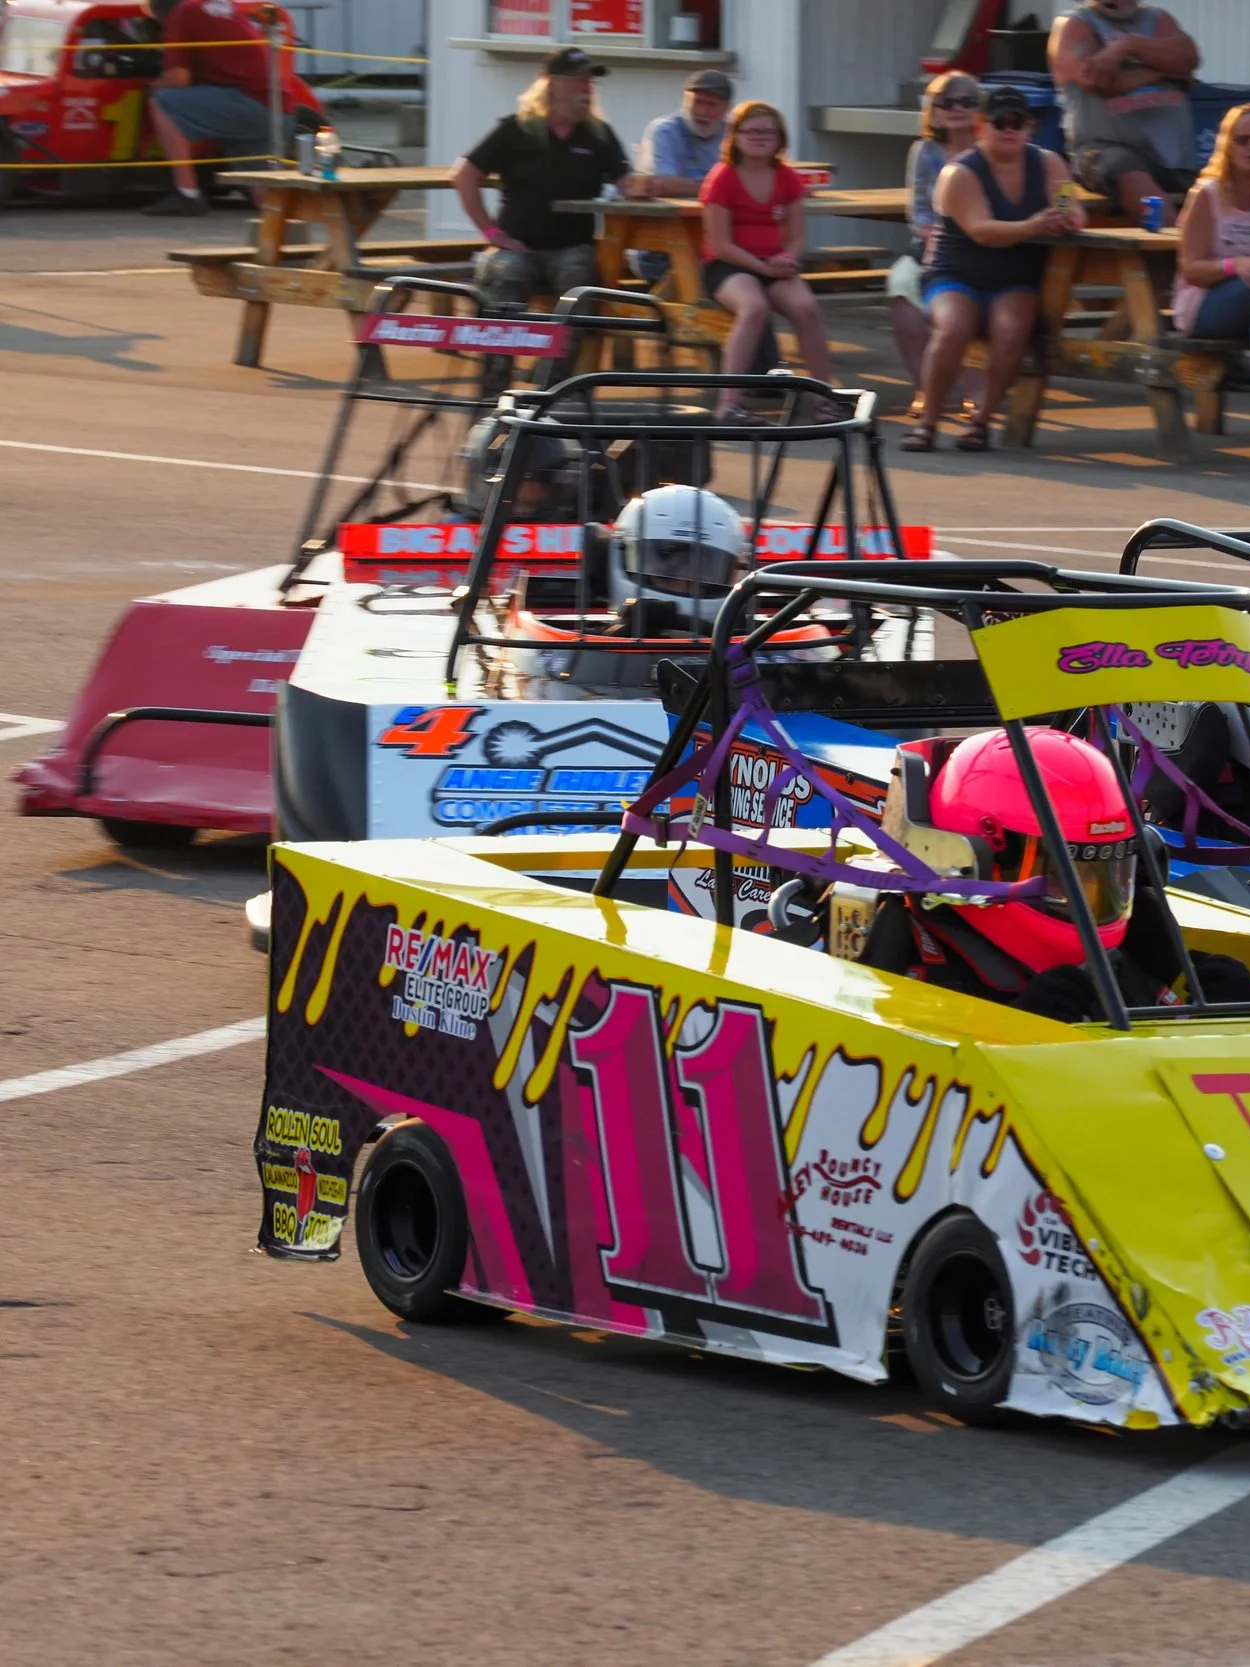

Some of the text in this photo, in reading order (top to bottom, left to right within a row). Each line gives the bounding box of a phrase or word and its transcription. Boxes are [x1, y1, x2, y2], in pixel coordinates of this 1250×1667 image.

[378, 527, 444, 554] BIG
[1058, 641, 1153, 674] Ella
[386, 924, 492, 993] RE/MAX
[266, 1106, 342, 1154] ROLLIN SOUL
[568, 977, 834, 1338] 11
[274, 1204, 297, 1244] BBQ
